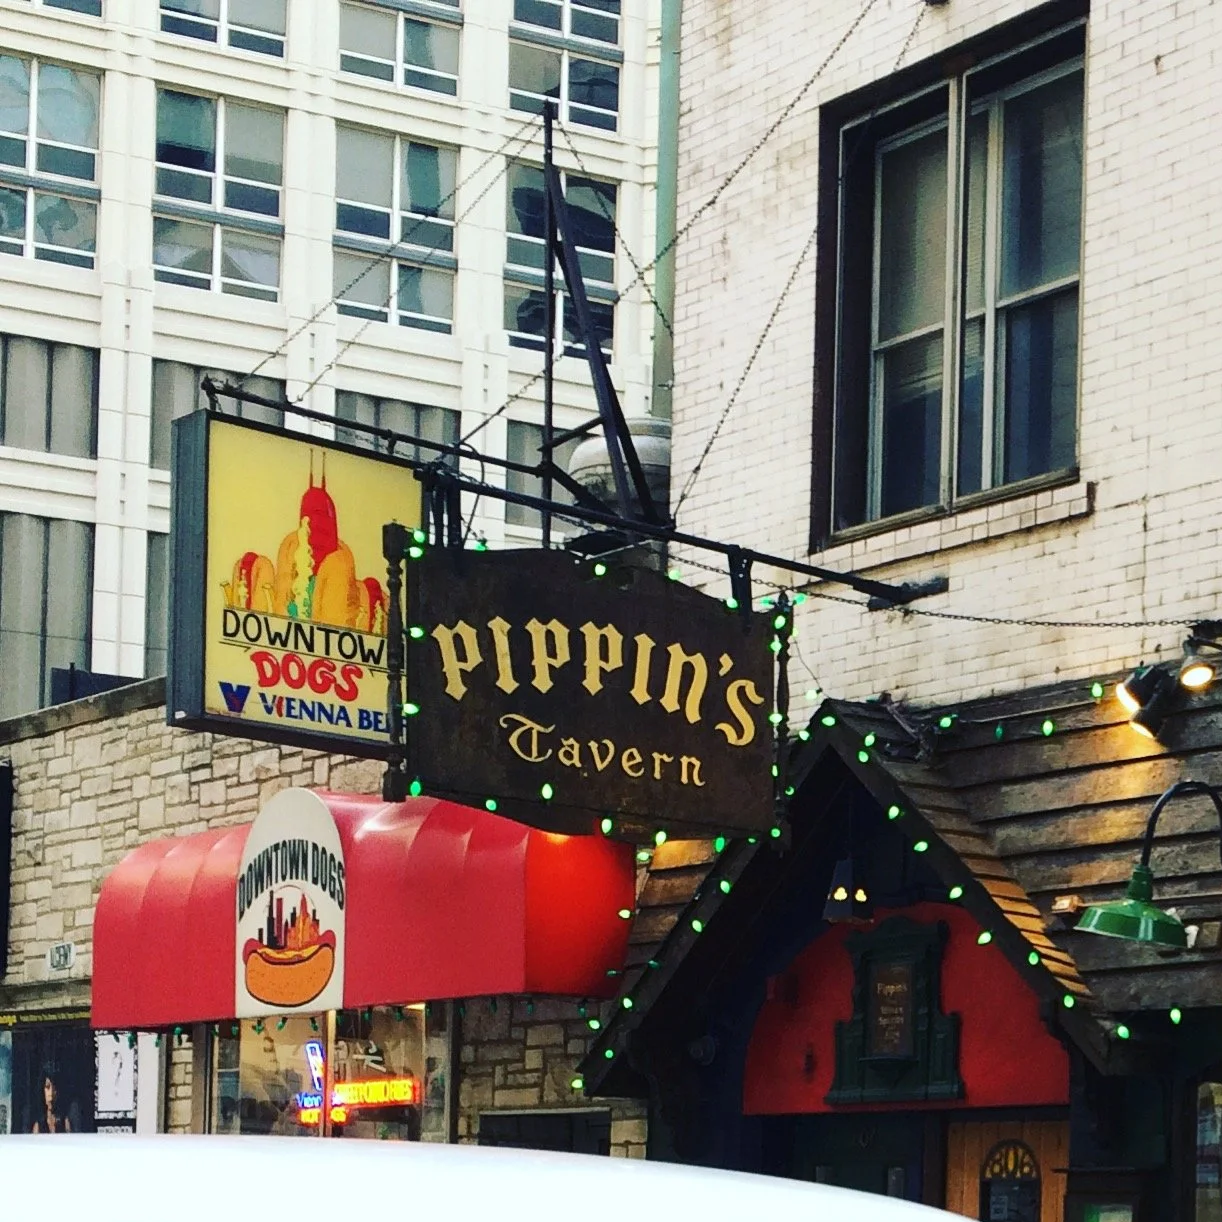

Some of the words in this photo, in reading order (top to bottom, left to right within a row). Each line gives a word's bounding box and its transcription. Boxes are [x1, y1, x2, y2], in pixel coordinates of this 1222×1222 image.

[250, 650, 364, 702] DOGS
[258, 692, 353, 728] VIENNA
[499, 712, 706, 786] Tavern
[238, 838, 309, 923] DOWNTOWN
[311, 841, 346, 911] DOGS
